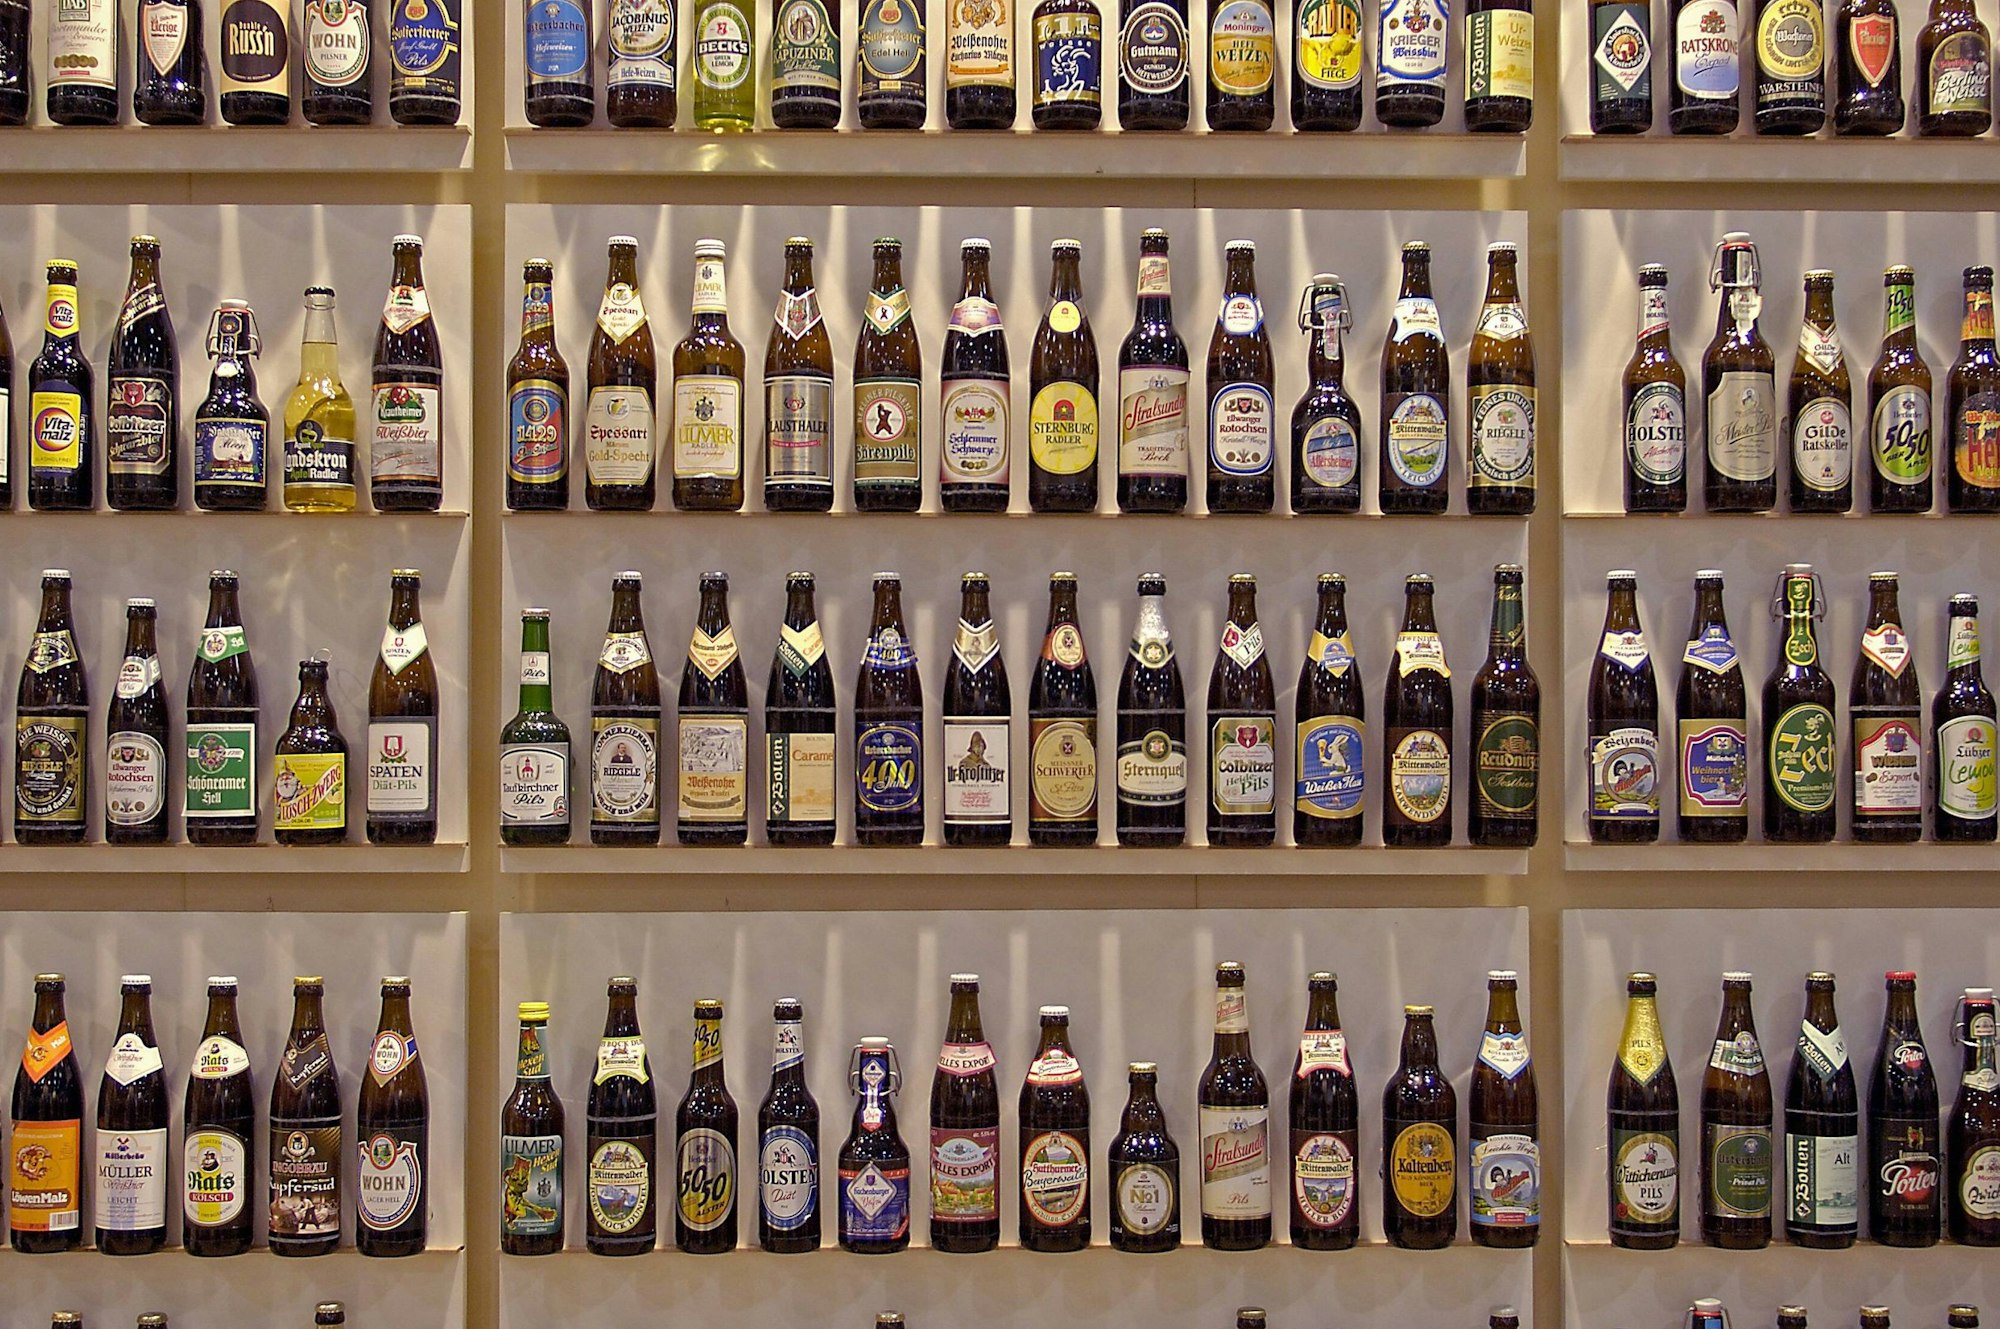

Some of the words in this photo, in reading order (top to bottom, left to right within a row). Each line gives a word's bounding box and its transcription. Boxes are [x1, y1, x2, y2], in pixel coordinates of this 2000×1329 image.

[612, 13, 669, 29] JACOBINUS
[1307, 3, 1357, 38] RADLER
[622, 24, 655, 34] WEIZEN
[1223, 23, 1265, 34] Moninger
[312, 33, 357, 49] WOHN
[699, 40, 748, 54] BECK'S
[1390, 35, 1441, 48] KRIEGER
[320, 53, 348, 62] PILSNER
[774, 47, 836, 65] KAPUZINER
[1131, 45, 1178, 58] Gutmann
[1216, 49, 1271, 64] WEIZEN
[1321, 68, 1347, 79] FIEGE
[1937, 70, 1990, 93] Berliner
[1946, 84, 1988, 104] Weisse
[1476, 393, 1507, 420] FEINES
[44, 417, 75, 430] Vita-
[766, 420, 829, 433] LAUSTHALER
[1033, 421, 1094, 436] STERNBURG
[1219, 424, 1268, 435] Rotochsen
[41, 430, 72, 441] malz
[377, 425, 429, 441] Weißbier
[517, 425, 557, 443] 1429
[590, 425, 648, 442] Spessart
[1045, 435, 1081, 445] RADLER
[1486, 427, 1527, 440] RIEGELE
[1802, 439, 1849, 452] Ratskeller
[1883, 420, 1913, 453] 50
[1904, 429, 1930, 461] 50
[589, 449, 650, 463] Gold-Specht
[1402, 470, 1437, 484] LEICHT
[33, 724, 71, 748] WEISSE
[791, 749, 834, 763] Carame
[1955, 747, 1991, 760] Lübzer
[369, 765, 423, 778] SPATEN
[603, 766, 641, 777] RIEGELE
[1036, 764, 1095, 781] SCHWERTER
[1219, 759, 1274, 773] Colbitzer
[862, 758, 917, 791] 400
[373, 778, 417, 791] Diät-Pils
[1241, 775, 1270, 796] Pils
[1305, 778, 1344, 795] Weißer
[513, 792, 544, 806] Pils
[617, 805, 633, 815] und
[633, 792, 650, 812] mild
[1395, 783, 1440, 819] KARWENDEL
[701, 1028, 719, 1050] 50
[1631, 1039, 1652, 1047] PILS
[200, 1055, 229, 1067] Rats
[376, 1049, 399, 1060] WOHN
[938, 1057, 961, 1068] ELLES
[962, 1056, 989, 1069] EXPORT
[505, 1139, 555, 1154] ULMER
[1398, 1158, 1453, 1174] Kaltenberg
[1834, 1152, 1851, 1166] Alt
[99, 1165, 154, 1179] MÜLLER
[961, 1159, 994, 1178] EXPORT
[187, 1170, 235, 1191] Rats
[362, 1174, 406, 1191] WOHN
[762, 1168, 817, 1186] OLSTEN
[1023, 1168, 1087, 1188] Bayerwald
[1881, 1156, 1940, 1197] Porter
[680, 1165, 708, 1196] 50
[697, 1172, 728, 1209] 50
[1640, 1187, 1663, 1199] PILS
[189, 1192, 233, 1203] KÖLSCH
[1226, 1192, 1249, 1205] Pils
[1299, 1195, 1329, 1224] HELLER
[1329, 1195, 1351, 1223] BOCK
[600, 1216, 627, 1231] BOCK
